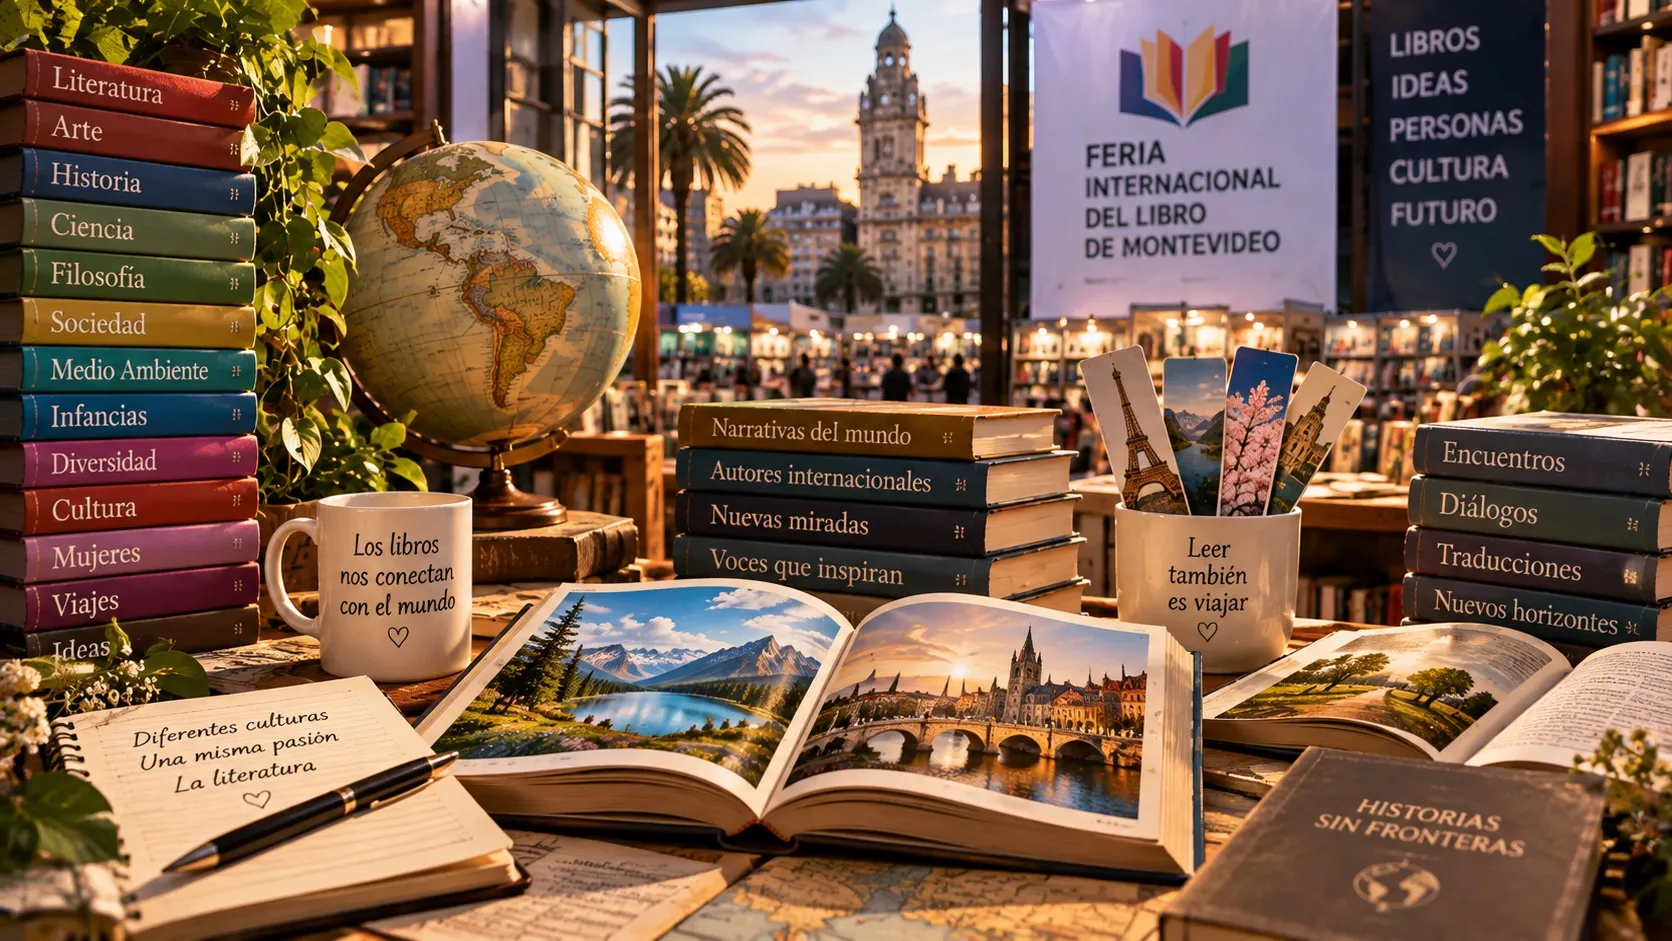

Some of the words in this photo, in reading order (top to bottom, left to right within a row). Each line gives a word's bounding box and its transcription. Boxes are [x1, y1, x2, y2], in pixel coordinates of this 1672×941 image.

[1389, 25, 1480, 57] LIBROS
[52, 65, 163, 105] Literatura
[1391, 69, 1468, 99] IDEAS
[51, 114, 103, 141] Arte
[1389, 108, 1524, 142] PERSONAS
[1085, 140, 1166, 168] FERIA
[1389, 154, 1509, 184] CULTURA
[51, 162, 142, 193] Historia
[1085, 167, 1281, 198] INTERNACIONAL
[51, 212, 134, 240] Ciencia
[1085, 207, 1129, 229] DEL
[1136, 202, 1206, 226] LIBRO
[1390, 197, 1497, 227] FUTURO
[1085, 237, 1114, 259] DE
[1122, 230, 1281, 257] MONTEVIDEO
[51, 261, 146, 289] Filosofía
[50, 310, 146, 335] Sociedad
[50, 357, 115, 381] Medio
[120, 358, 209, 381] Ambiente
[51, 404, 148, 429] Infancias
[711, 417, 805, 441] Narrativas
[810, 419, 838, 443] del
[845, 424, 912, 446] mundo
[51, 448, 157, 476] Diversidad
[1442, 440, 1566, 473] Encuentros
[710, 459, 782, 485] Autores
[787, 464, 932, 492] internacionales
[52, 496, 137, 522] Cultura
[710, 503, 782, 530] Nuevas
[788, 511, 869, 536] miradas
[1439, 491, 1538, 528] Diálogos
[52, 543, 141, 573] Mujeres
[353, 533, 383, 556] Los
[390, 531, 439, 556] libros
[1187, 536, 1231, 558] Leer
[340, 569, 368, 586] nos
[375, 564, 454, 586] conectan
[709, 547, 768, 573] Voces
[774, 557, 812, 581] que
[817, 555, 903, 587] inspiran
[1168, 564, 1248, 585] también
[1437, 541, 1582, 581] Traducciones
[52, 591, 119, 618] Viajes
[340, 598, 369, 616] con
[375, 593, 391, 615] el
[398, 588, 456, 615] mundo
[1168, 595, 1187, 611] es
[1194, 592, 1249, 618] viajar
[1433, 588, 1507, 620] Nuevos
[1513, 598, 1618, 635] horizontes
[52, 640, 111, 662] Ideas
[133, 721, 238, 749] Diferentes
[245, 710, 329, 732] culturas
[140, 752, 187, 772] Una
[194, 744, 265, 762] misma
[273, 731, 339, 756] pasión
[174, 774, 205, 794] La
[213, 761, 317, 786] literatura
[1357, 798, 1501, 832] HISTORIAS
[1314, 813, 1361, 834] SIN
[1365, 822, 1526, 857] FRONTERAS
